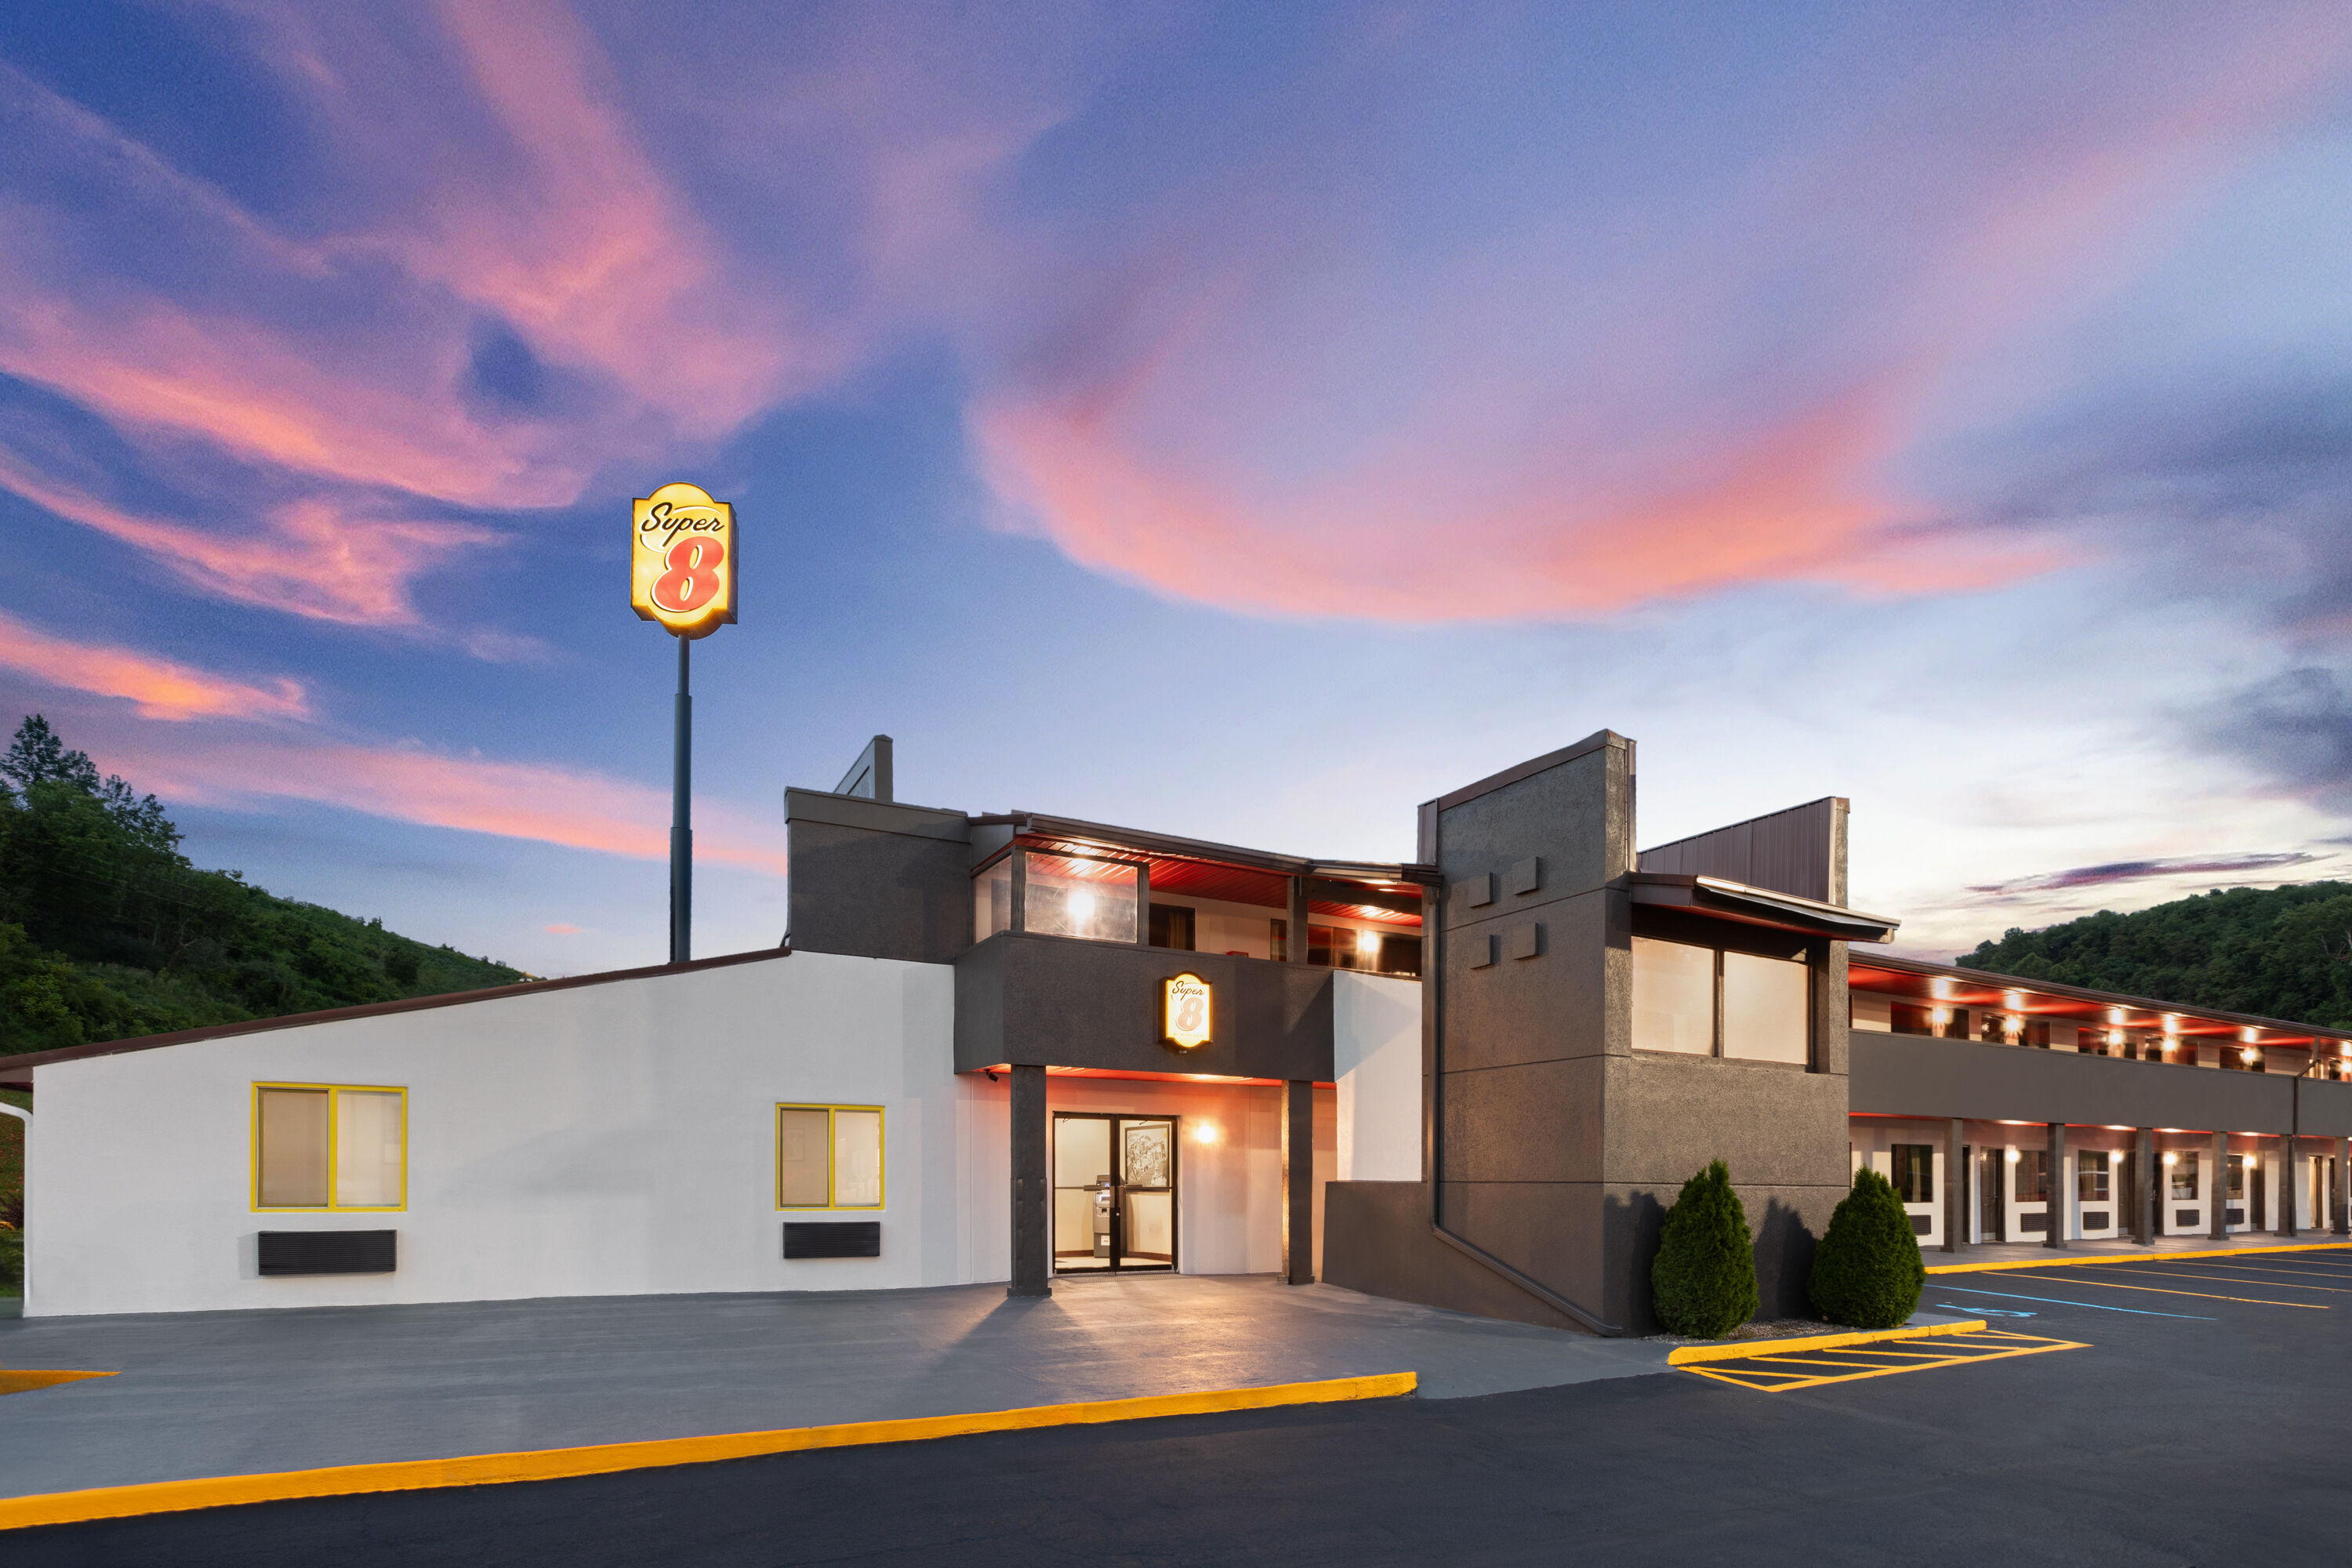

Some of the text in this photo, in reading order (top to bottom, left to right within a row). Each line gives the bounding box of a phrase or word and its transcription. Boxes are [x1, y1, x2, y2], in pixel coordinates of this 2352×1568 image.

[640, 502, 724, 547] Super
[651, 536, 724, 612] 8
[1172, 981, 1203, 1001] Super
[1176, 997, 1203, 1031] 8
